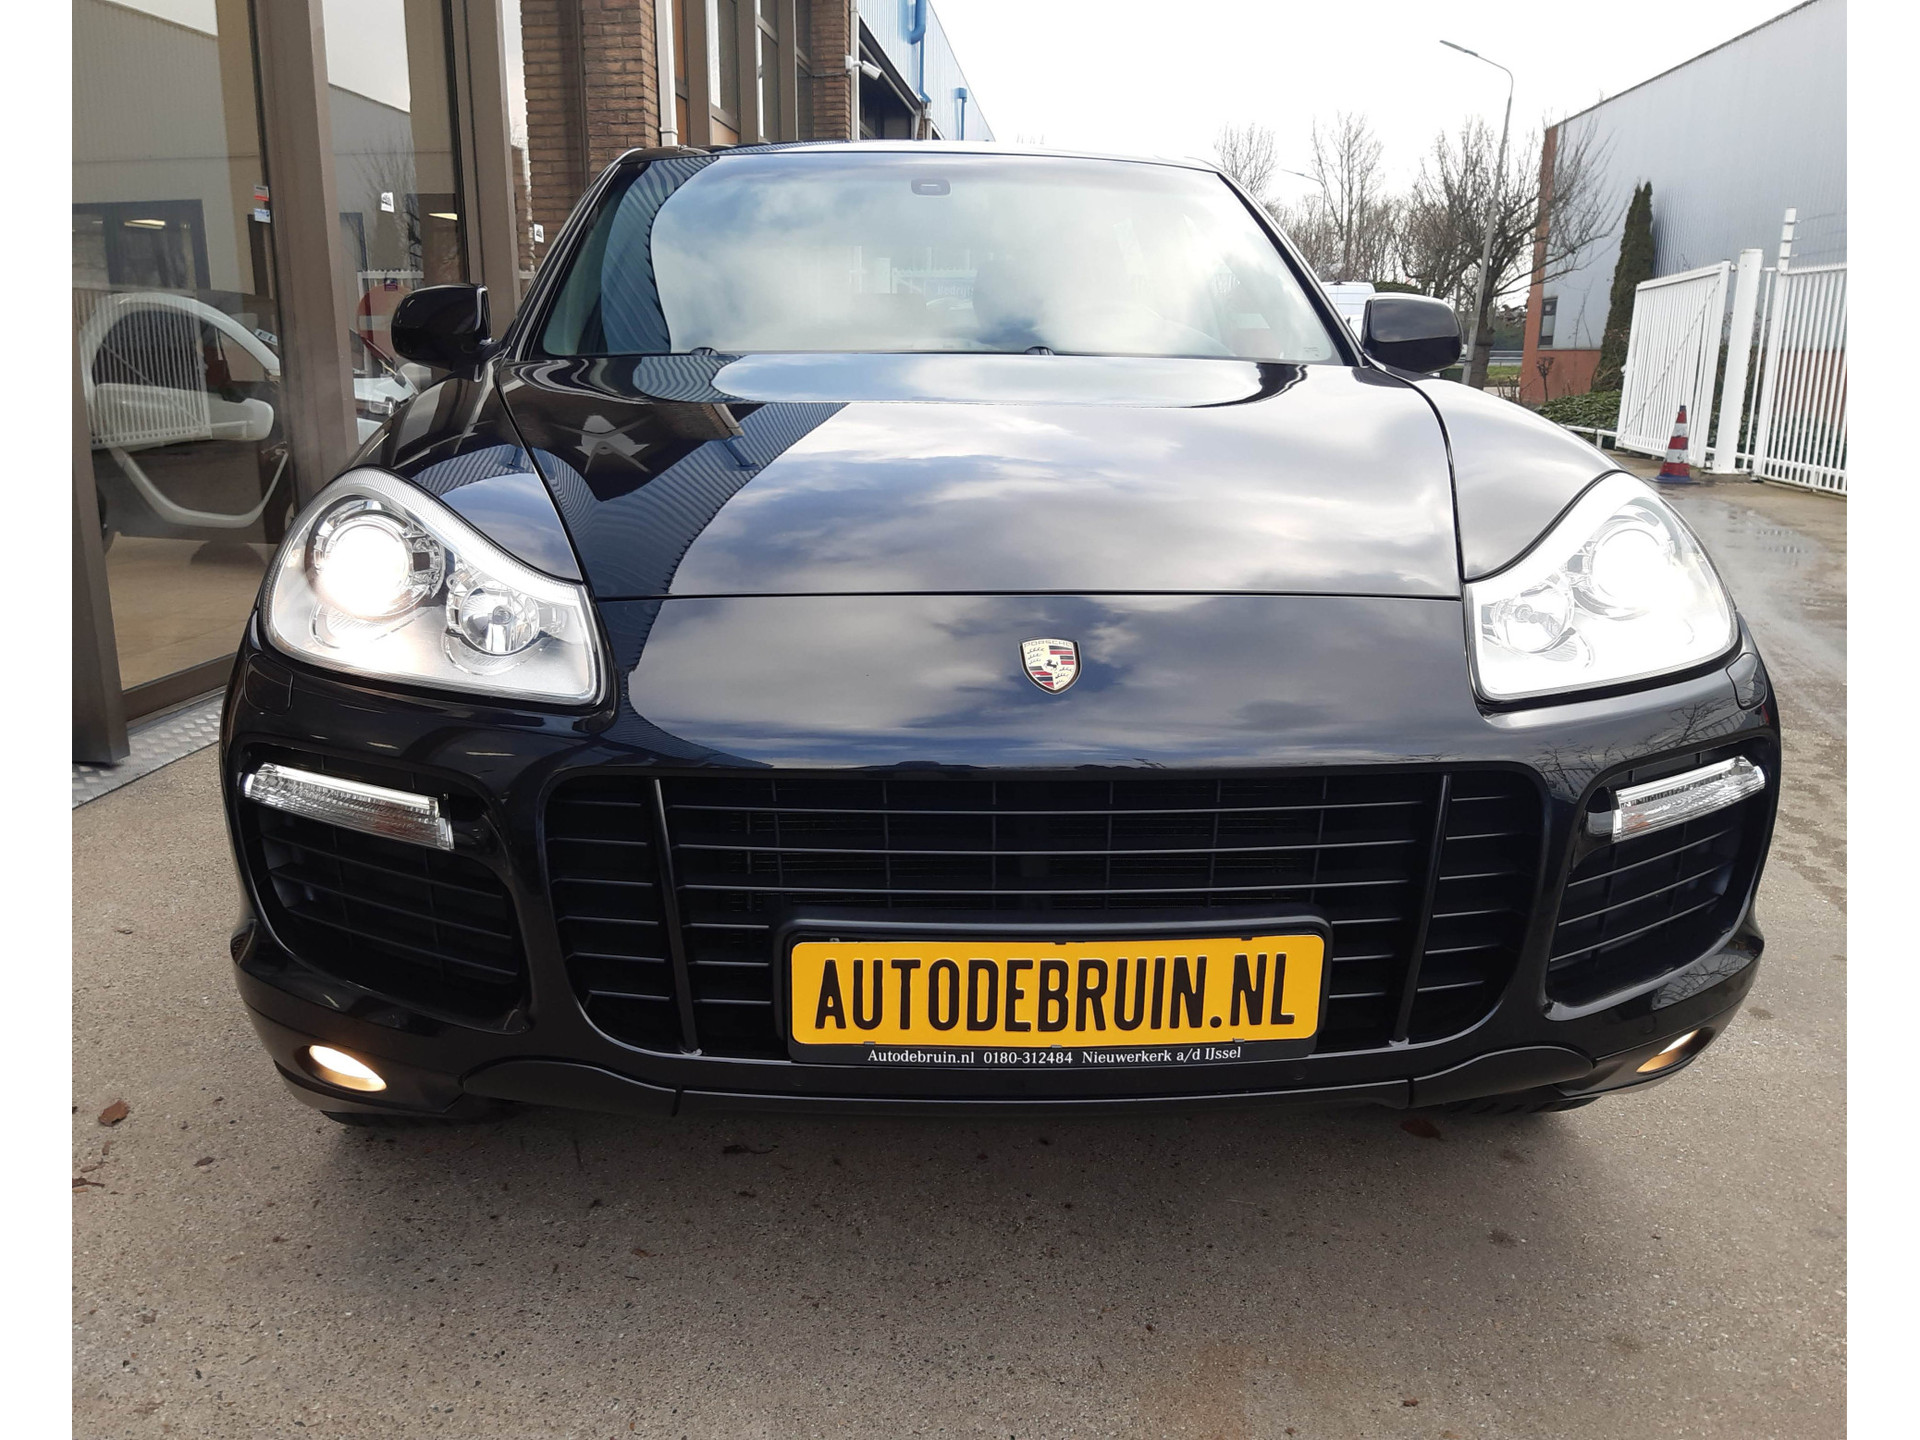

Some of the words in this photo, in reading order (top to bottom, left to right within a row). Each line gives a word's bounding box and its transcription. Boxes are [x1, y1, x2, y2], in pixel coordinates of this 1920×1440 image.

[815, 953, 1295, 1031] AUTODEBRUIN.NL
[867, 1049, 975, 1064] Autodebruin.nl
[983, 1051, 1073, 1064] 0180-312484
[1081, 1050, 1172, 1064] Nieuwerkerk
[1176, 1048, 1201, 1063] a/d
[1204, 1046, 1241, 1061] IJssel
